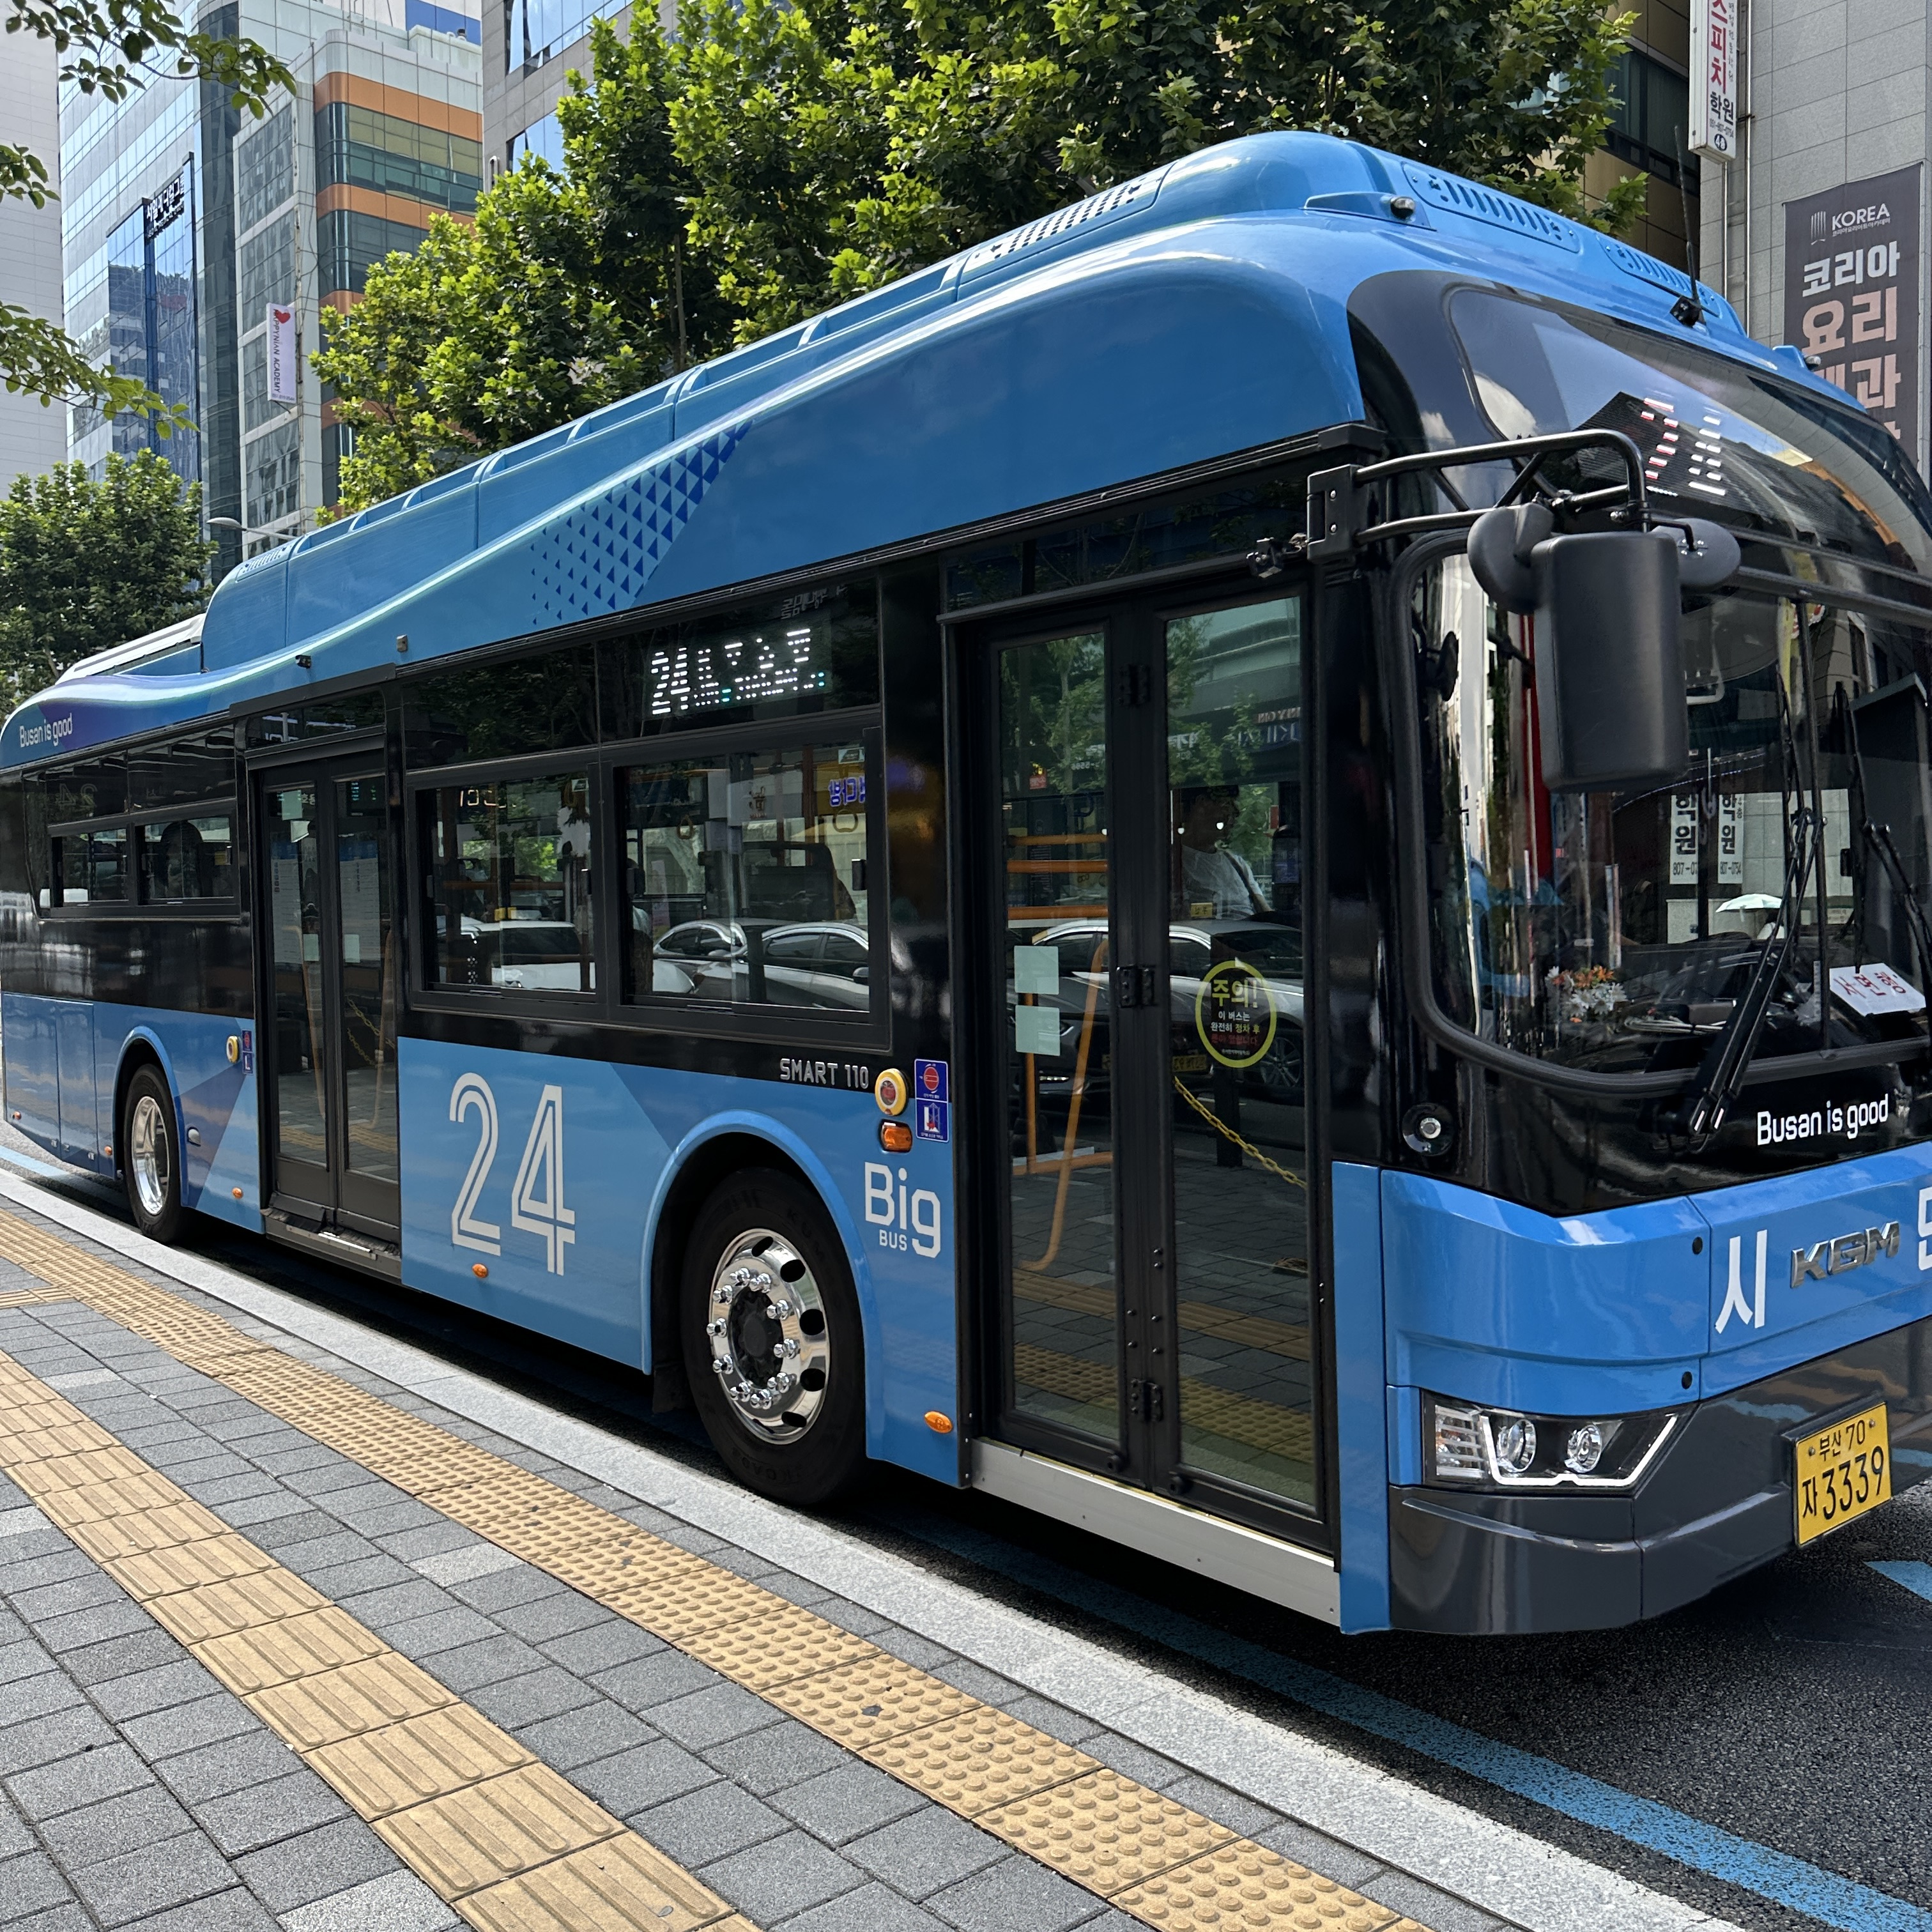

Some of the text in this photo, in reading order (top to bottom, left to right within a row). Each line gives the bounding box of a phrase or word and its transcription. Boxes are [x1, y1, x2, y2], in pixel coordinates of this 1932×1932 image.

[1710, 91, 1733, 125] 학원
[1832, 203, 1890, 231] KOREA
[1802, 240, 1900, 297] 코리아
[1802, 286, 1897, 357] 요리
[19, 712, 73, 748] Busan is good
[1212, 979, 1258, 1009] 주의!
[1211, 1022, 1261, 1034] 완전히 정차 후
[1218, 1011, 1251, 1022] 이 버스는
[780, 1058, 869, 1089] SMART 110
[1757, 1093, 1889, 1146] Busan is good
[449, 1072, 575, 1276] 24
[864, 1162, 941, 1259] Big
[879, 1229, 907, 1251] BUS
[1790, 1220, 1900, 1289] KGM
